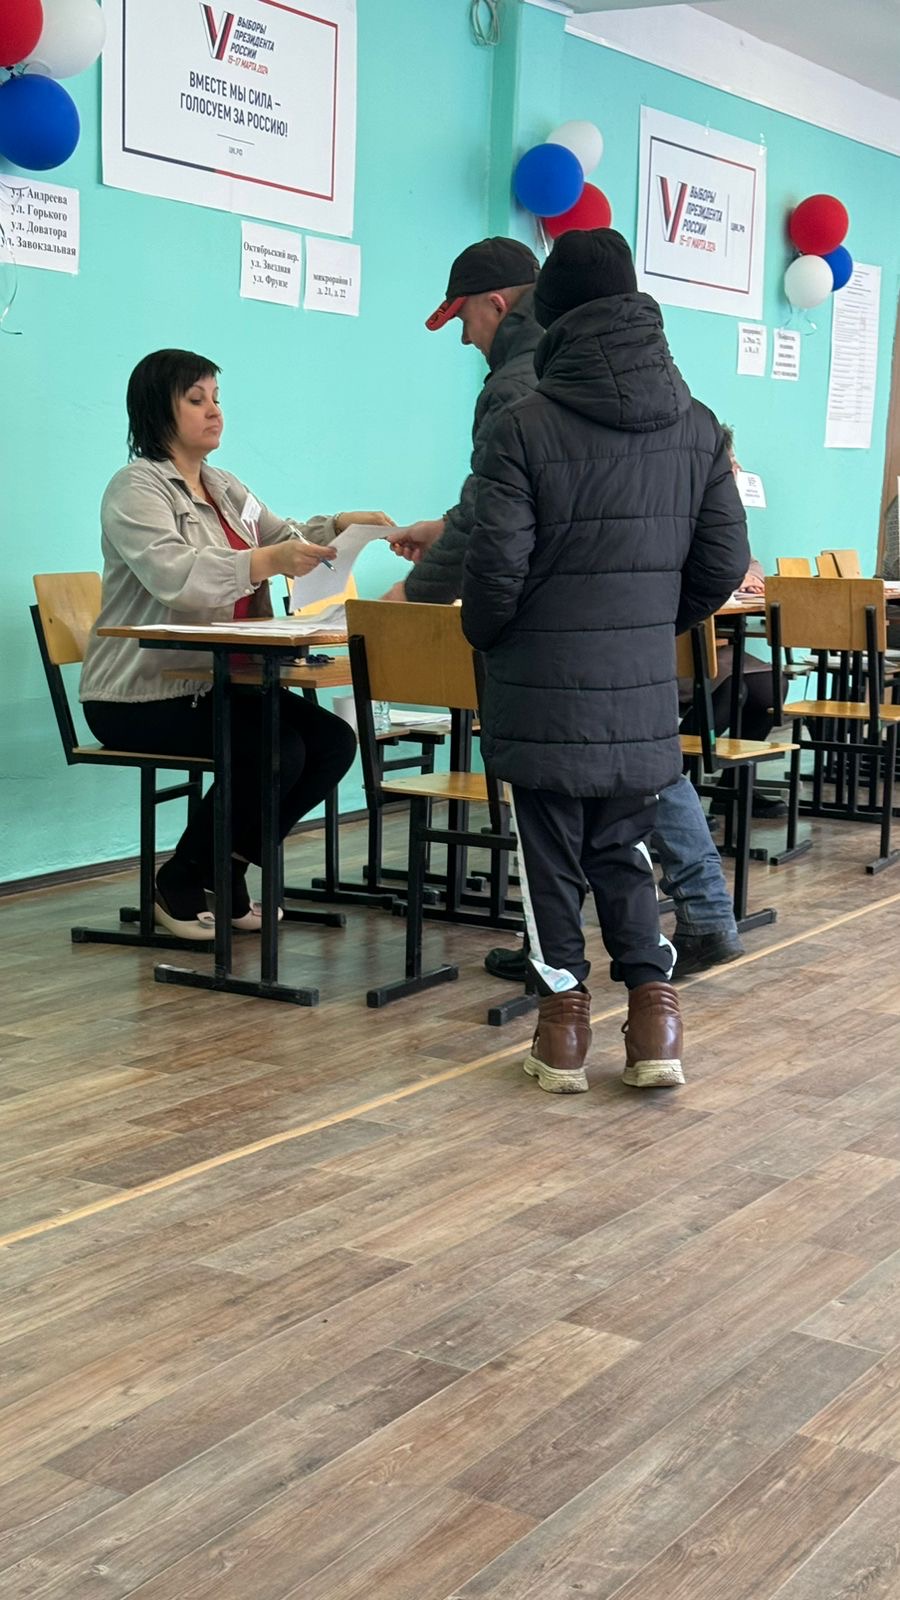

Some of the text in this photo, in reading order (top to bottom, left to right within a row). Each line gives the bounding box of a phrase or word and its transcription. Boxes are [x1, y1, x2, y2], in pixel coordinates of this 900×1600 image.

[237, 16, 267, 34] ВЫБОРЫ
[234, 30, 275, 51] ПРЕЗИДЕНТА
[230, 42, 257, 59] РОССИИ
[241, 60, 257, 71] МАРТА
[189, 71, 227, 97] ВМЕСТЕ
[229, 83, 246, 103] МЫ
[249, 88, 273, 110] СИЛА
[180, 92, 288, 138] ГОЛОСУЕМ ЗА РОССИЮ!
[11, 187, 68, 205] ул. Андреева
[689, 185, 717, 203] ВЫБОРЫ
[11, 204, 68, 221] ул. Горького
[686, 202, 723, 223] ПРЕЗИДЕНТА
[11, 221, 67, 240] ул. Доватора
[682, 219, 707, 236] РОССИИ
[1, 236, 76, 256] ул. Завокзальная
[243, 241, 299, 263] Октябрьский пер.
[250, 259, 291, 274] ул. Звездная
[252, 274, 288, 288] ул. Фрунзе
